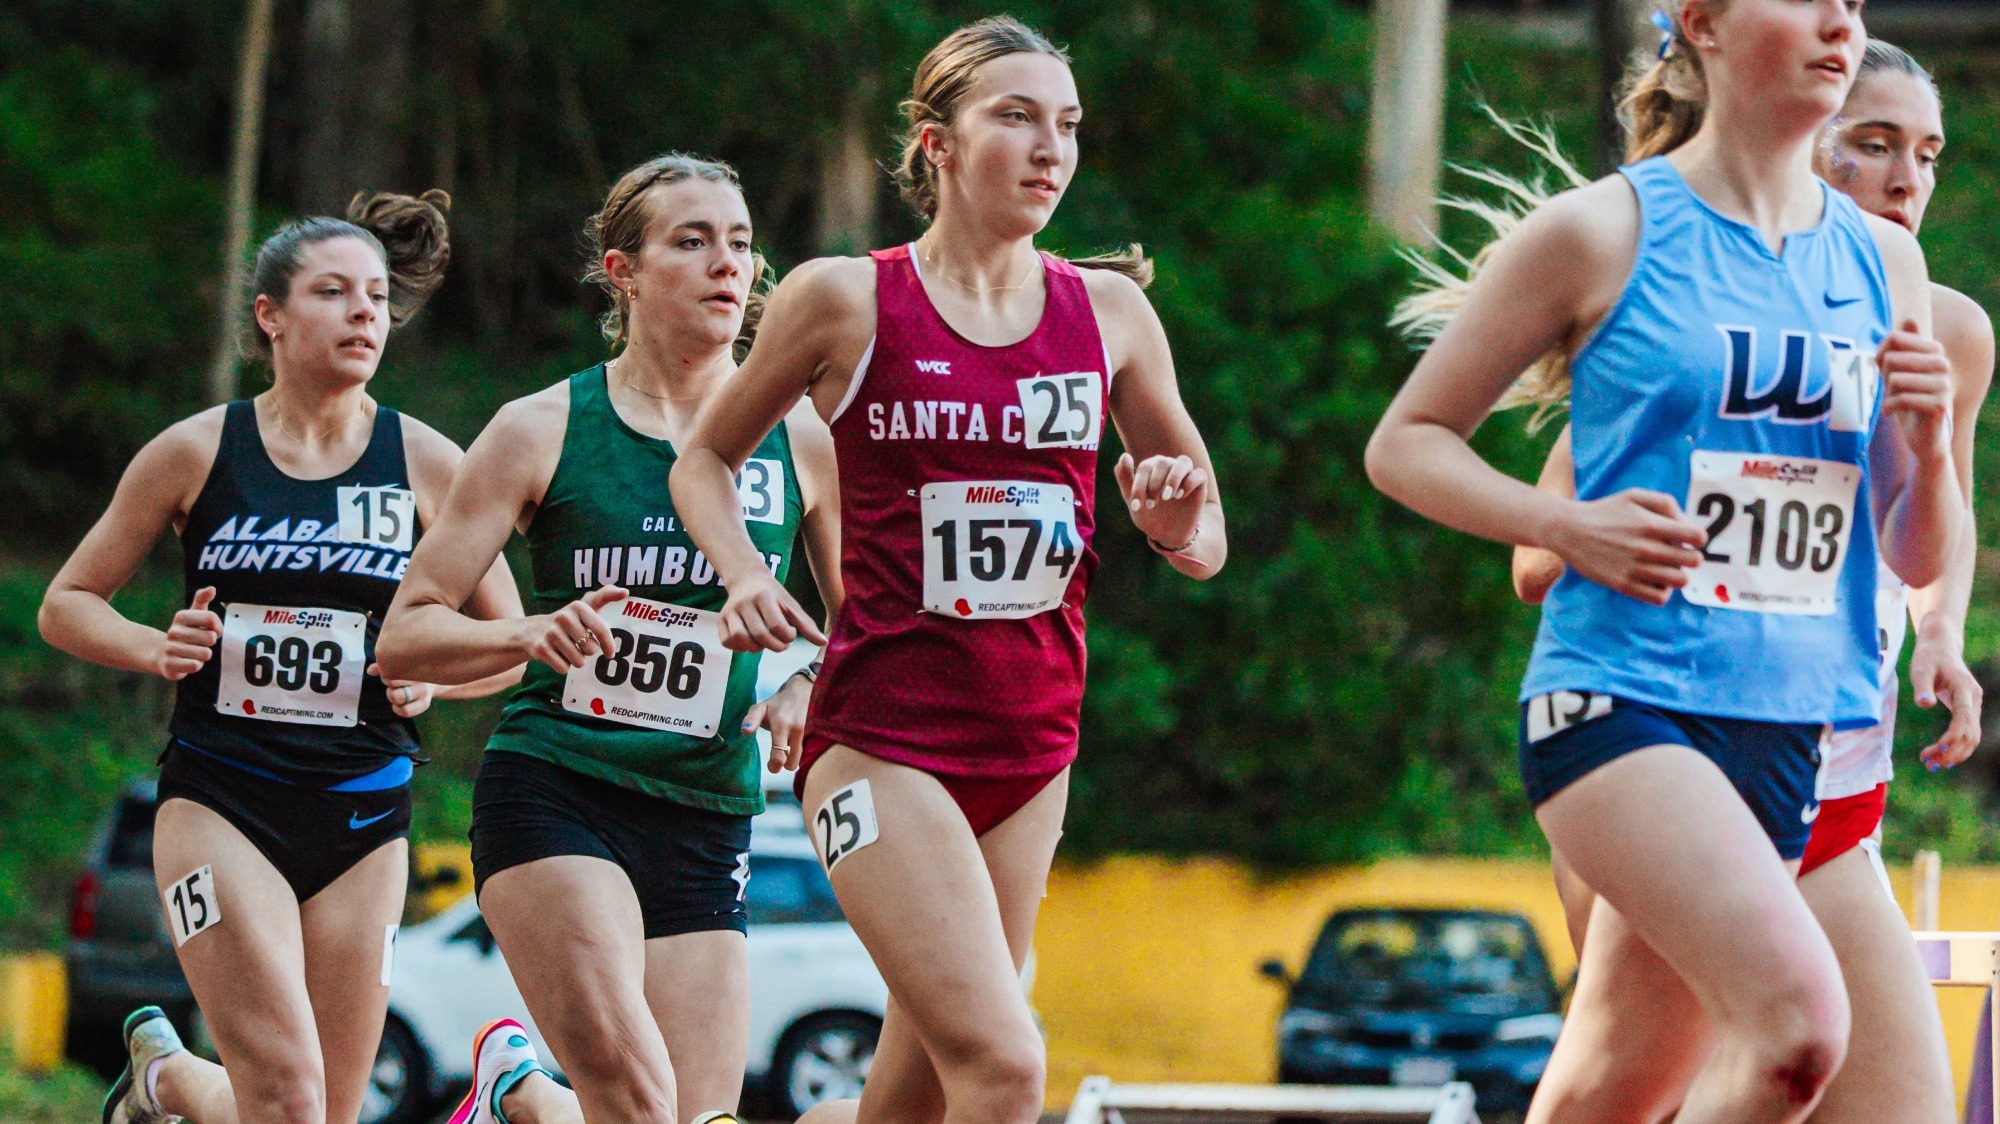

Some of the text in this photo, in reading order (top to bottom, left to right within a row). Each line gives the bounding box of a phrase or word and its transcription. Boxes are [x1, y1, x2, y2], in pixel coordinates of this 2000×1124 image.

[915, 360, 951, 375] WCC
[868, 401, 989, 441] SANTA
[1032, 377, 1091, 443] 25
[735, 461, 771, 517] 3
[965, 486, 1040, 507] MileSplit
[207, 514, 341, 543] ALABA
[351, 491, 401, 543] 15
[642, 516, 675, 532] CAL
[1696, 493, 1844, 573] 2103
[573, 546, 782, 589] HUMBOT
[932, 519, 1076, 582] 1574
[263, 610, 333, 629] MileSplit
[622, 601, 699, 628] MileSplit
[244, 634, 343, 694] 693
[595, 628, 706, 700] 856
[261, 705, 334, 719] REDCAPTIMING.COM
[611, 706, 693, 728] REDCAPTIMING.COM
[817, 789, 860, 871] 25
[173, 873, 207, 936] 15
